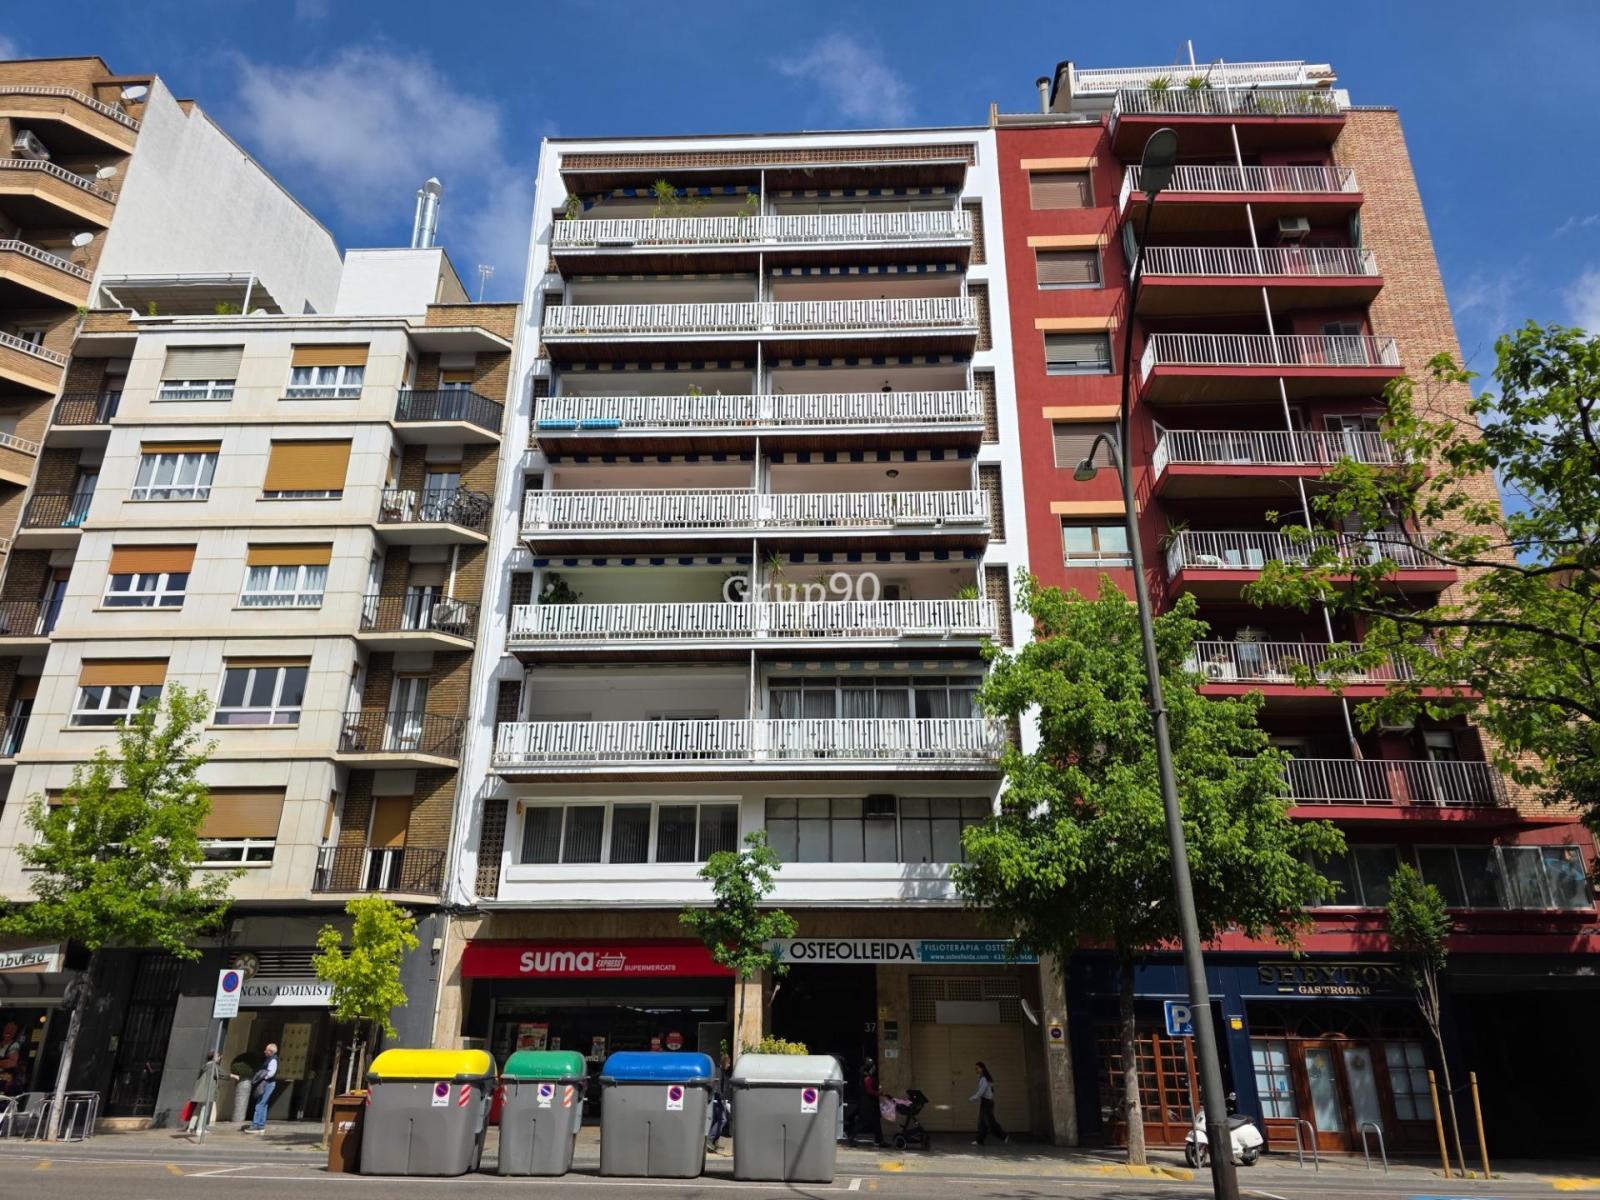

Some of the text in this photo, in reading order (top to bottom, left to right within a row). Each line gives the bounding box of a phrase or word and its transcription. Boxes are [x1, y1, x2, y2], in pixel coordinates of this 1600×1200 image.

[790, 942, 915, 959] OSTEOLLEIDA
[519, 951, 676, 972] suma EXPRESS SUPERMERCATS
[240, 985, 268, 996] NCAS
[1298, 985, 1371, 995] GASTROBAR
[1171, 1005, 1192, 1032] P
[864, 1022, 877, 1033] 37
